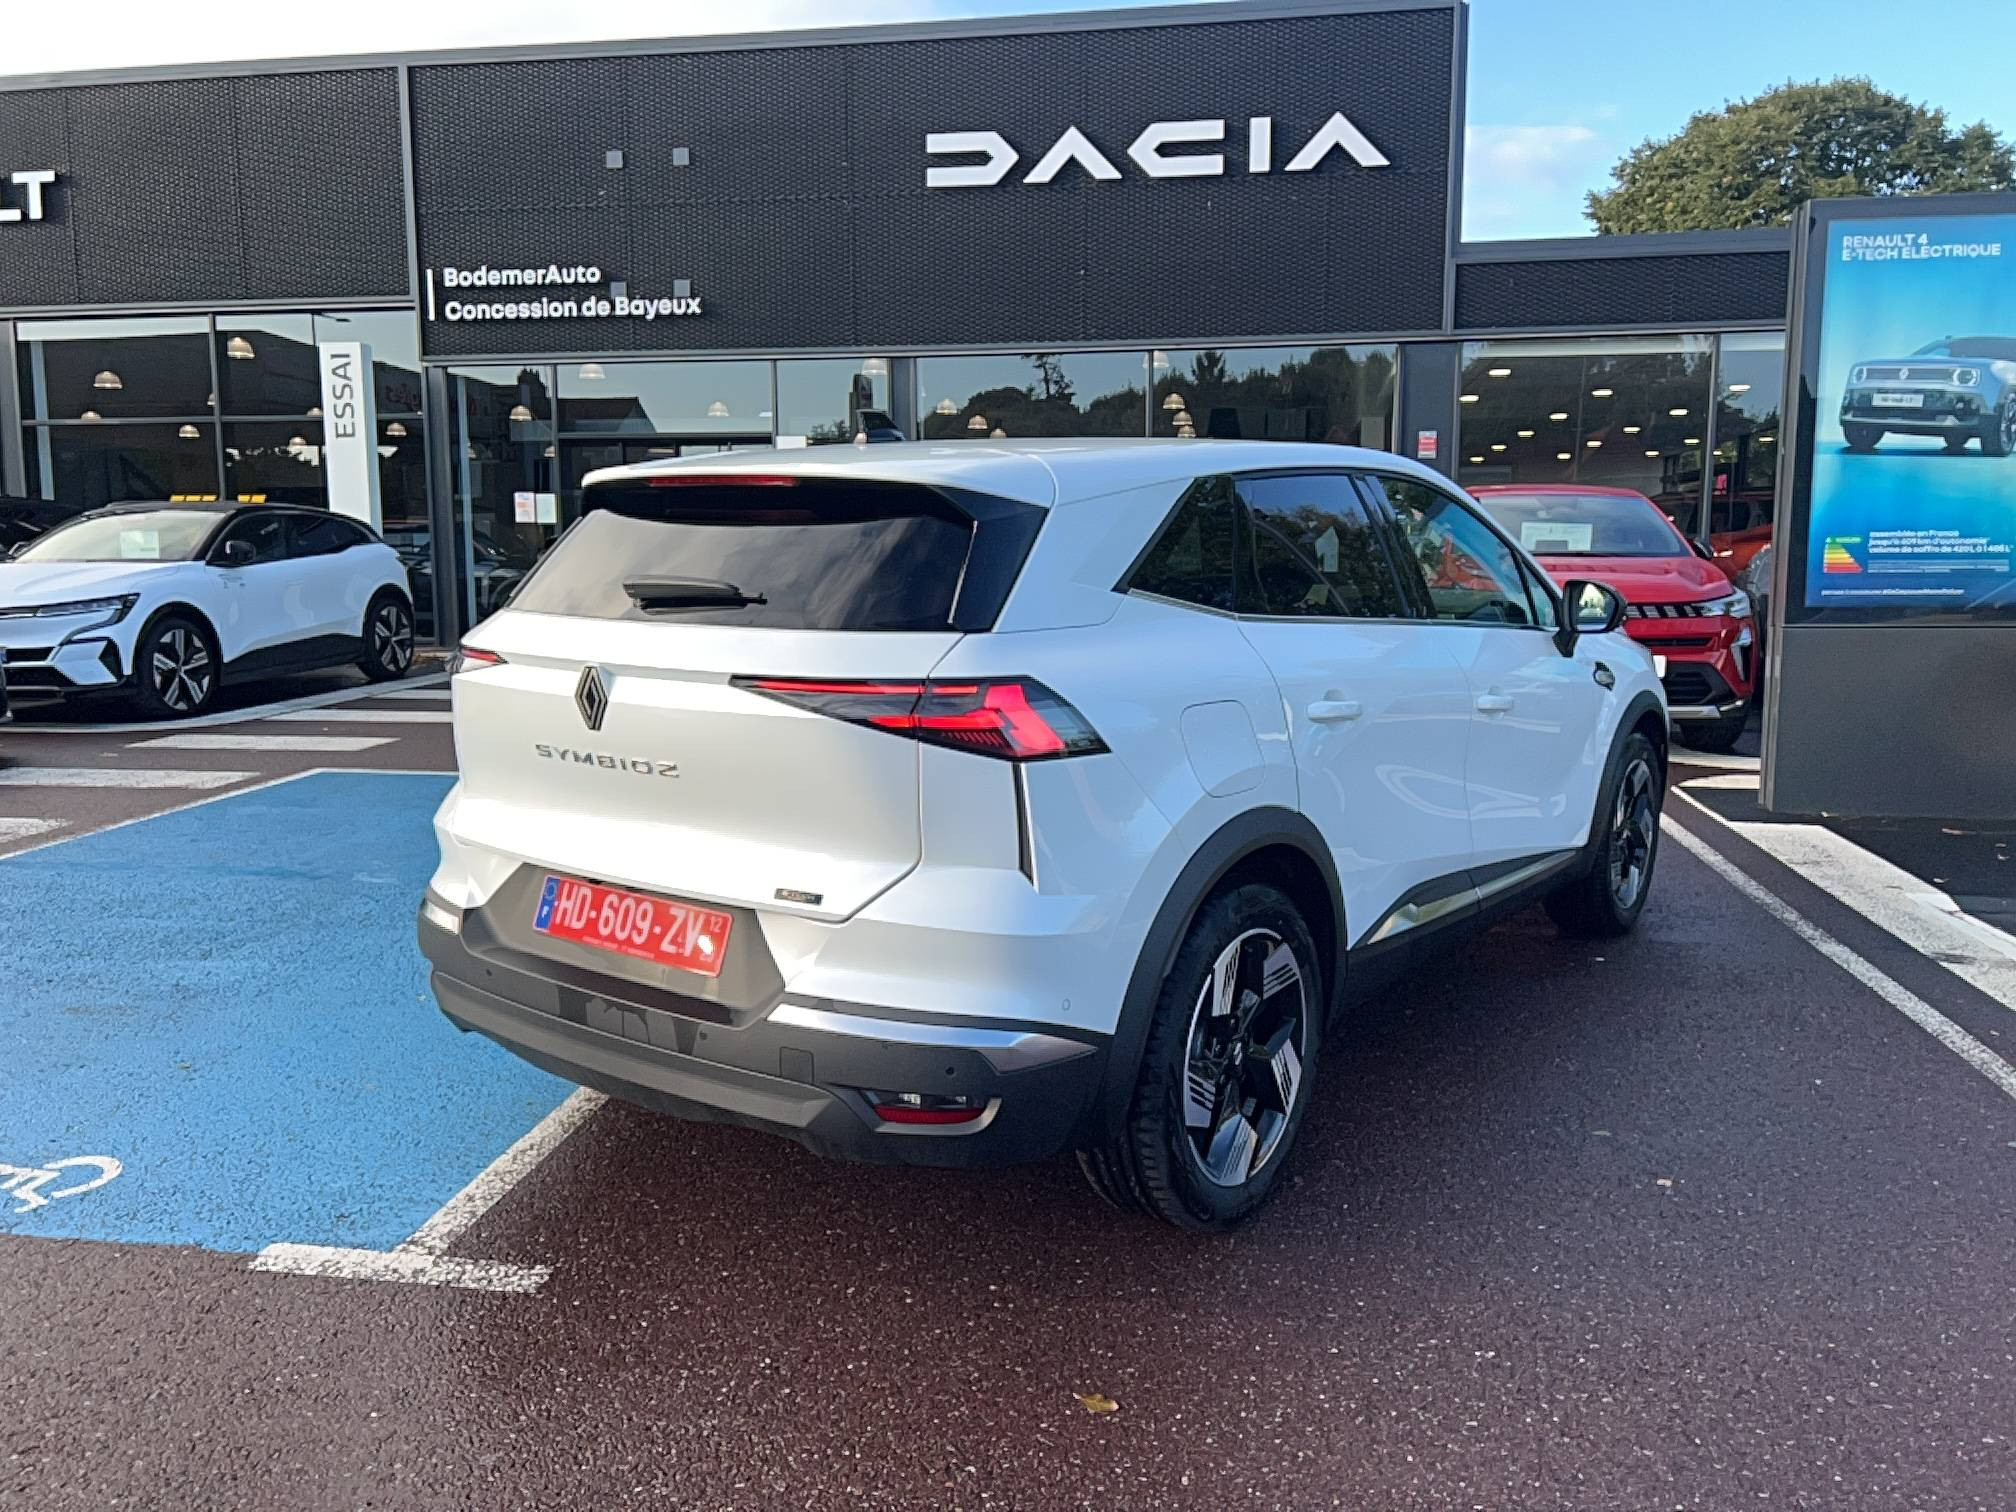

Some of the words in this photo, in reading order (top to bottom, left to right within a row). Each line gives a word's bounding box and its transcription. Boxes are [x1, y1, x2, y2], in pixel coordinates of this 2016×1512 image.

[926, 111, 1391, 188] DACIA
[1843, 234, 1915, 247] RENAULT
[1918, 233, 1929, 245] 4
[1842, 247, 1898, 260] E-TECH
[443, 265, 601, 287] BodemerAuto
[445, 297, 578, 321] Concession
[581, 296, 611, 317] de
[614, 296, 701, 320] Bayeux
[331, 354, 355, 438] ESSAI
[535, 744, 680, 779] SYMBIOZ
